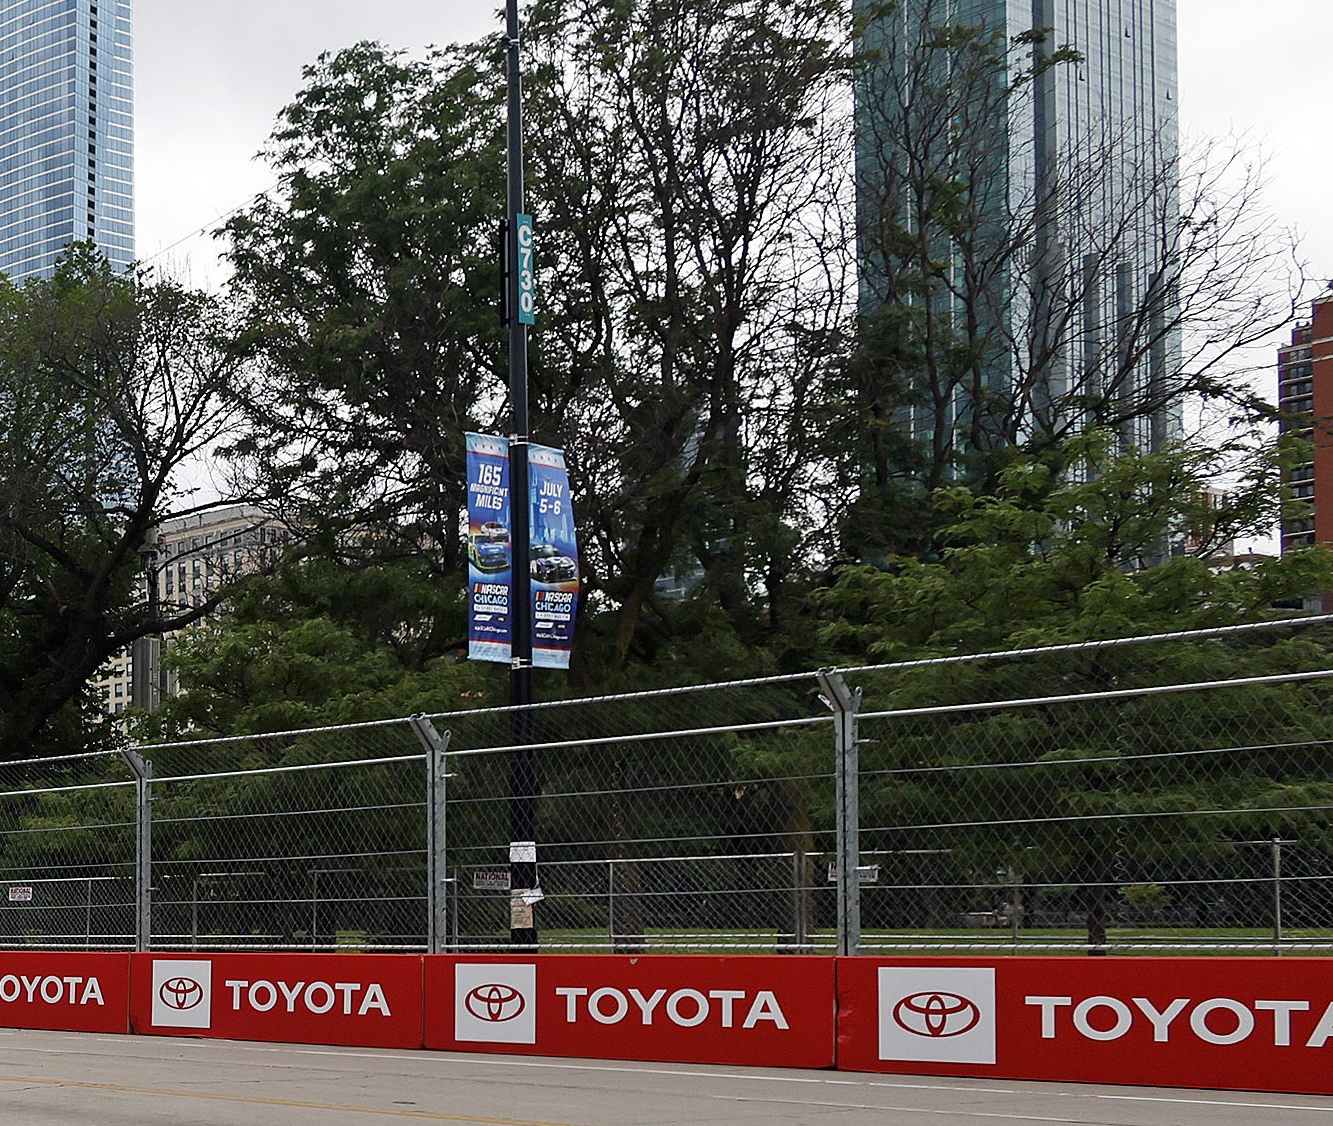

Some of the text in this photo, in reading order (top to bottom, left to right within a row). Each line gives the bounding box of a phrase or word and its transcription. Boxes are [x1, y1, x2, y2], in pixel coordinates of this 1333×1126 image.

[518, 224, 533, 313] C730
[478, 463, 502, 486] 165
[539, 480, 563, 498] JULY
[475, 493, 503, 511] MILES
[539, 498, 561, 515] 5-6
[481, 583, 509, 596] NASCAR
[544, 591, 573, 603] NASCAR
[474, 594, 508, 606] CHICAGO
[535, 602, 571, 612] CHICAGO
[225, 979, 391, 1017] TOYOTA
[555, 986, 790, 1030] TOYOTA
